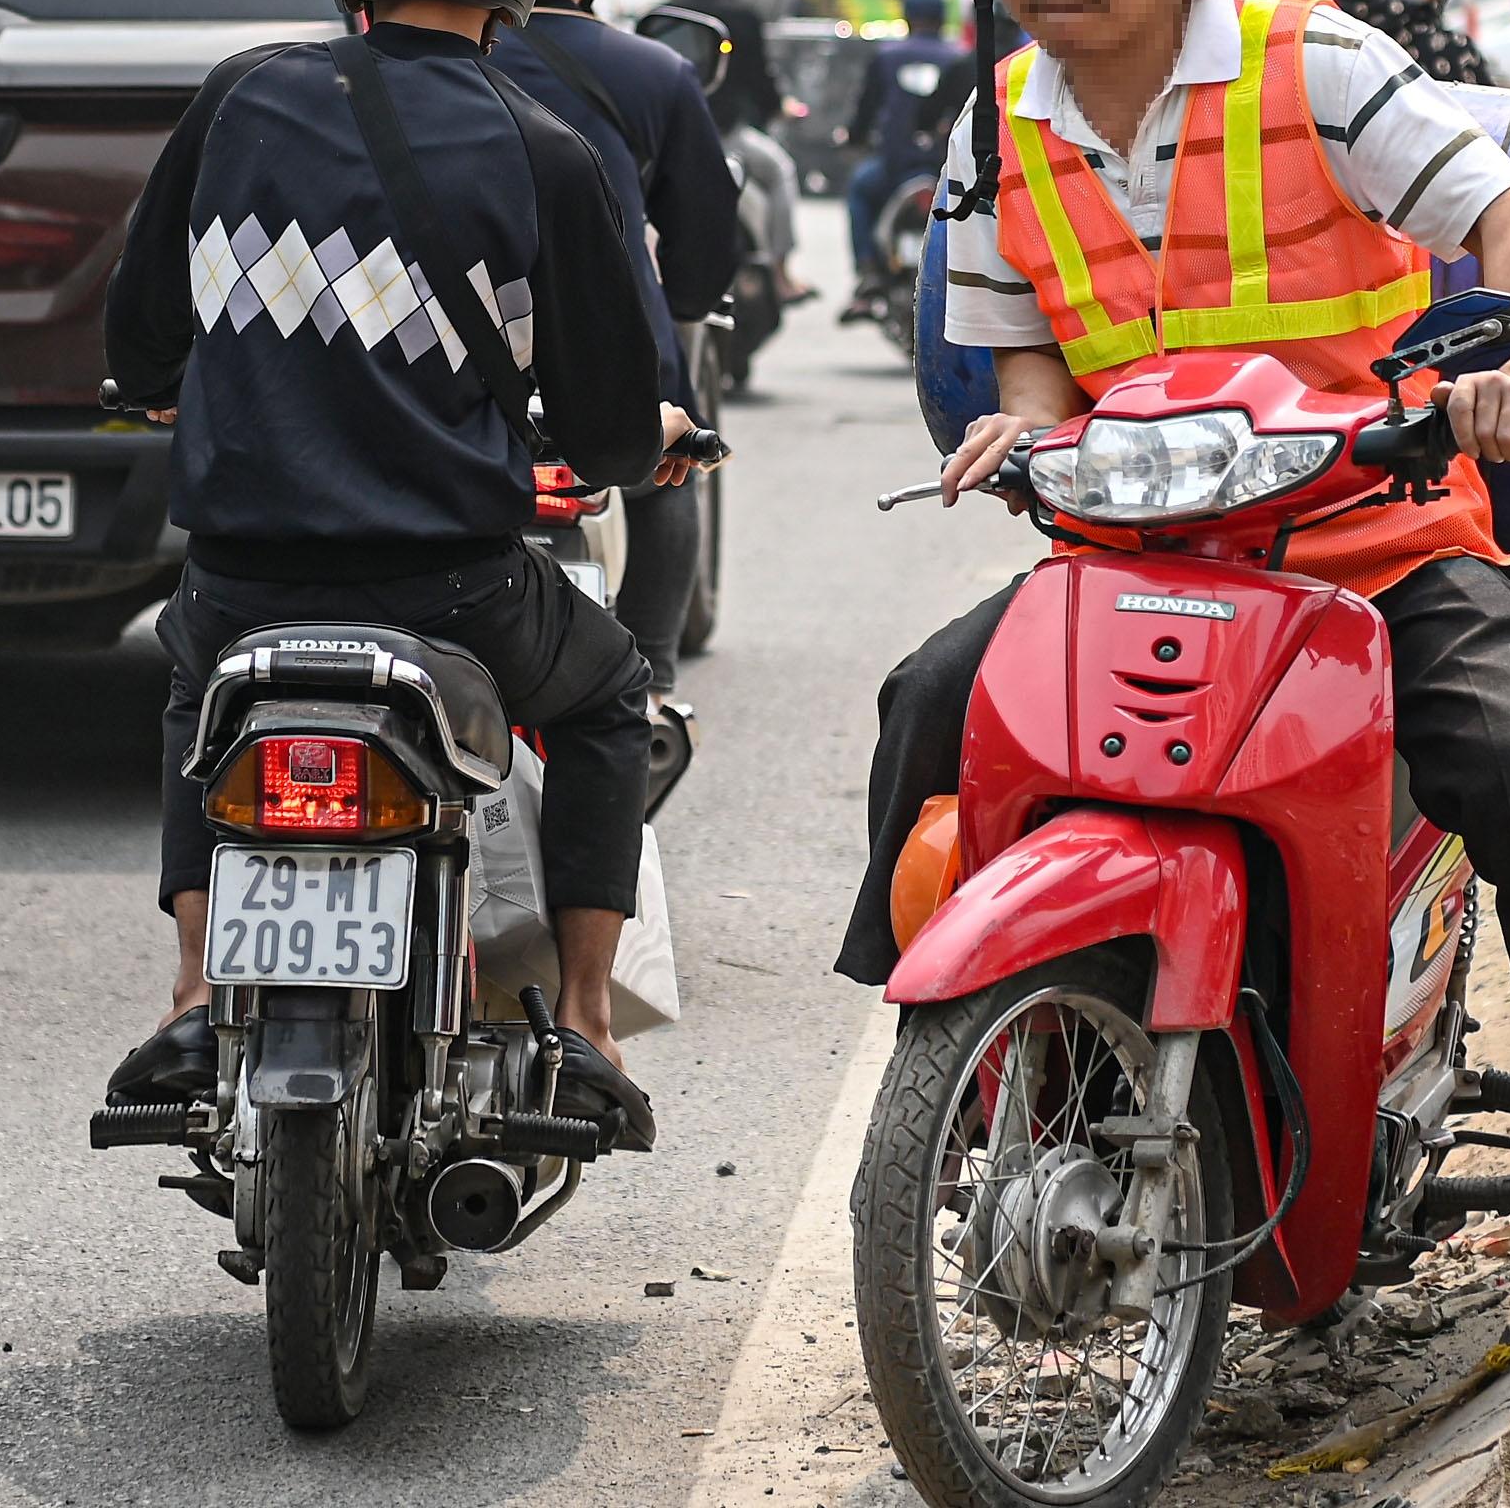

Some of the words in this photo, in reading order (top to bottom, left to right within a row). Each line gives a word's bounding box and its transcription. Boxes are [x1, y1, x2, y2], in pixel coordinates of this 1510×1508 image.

[1118, 595, 1229, 619] HONDA
[278, 639, 381, 653] HONDA
[241, 856, 382, 913] 29-M1
[220, 919, 396, 976] 209.53
